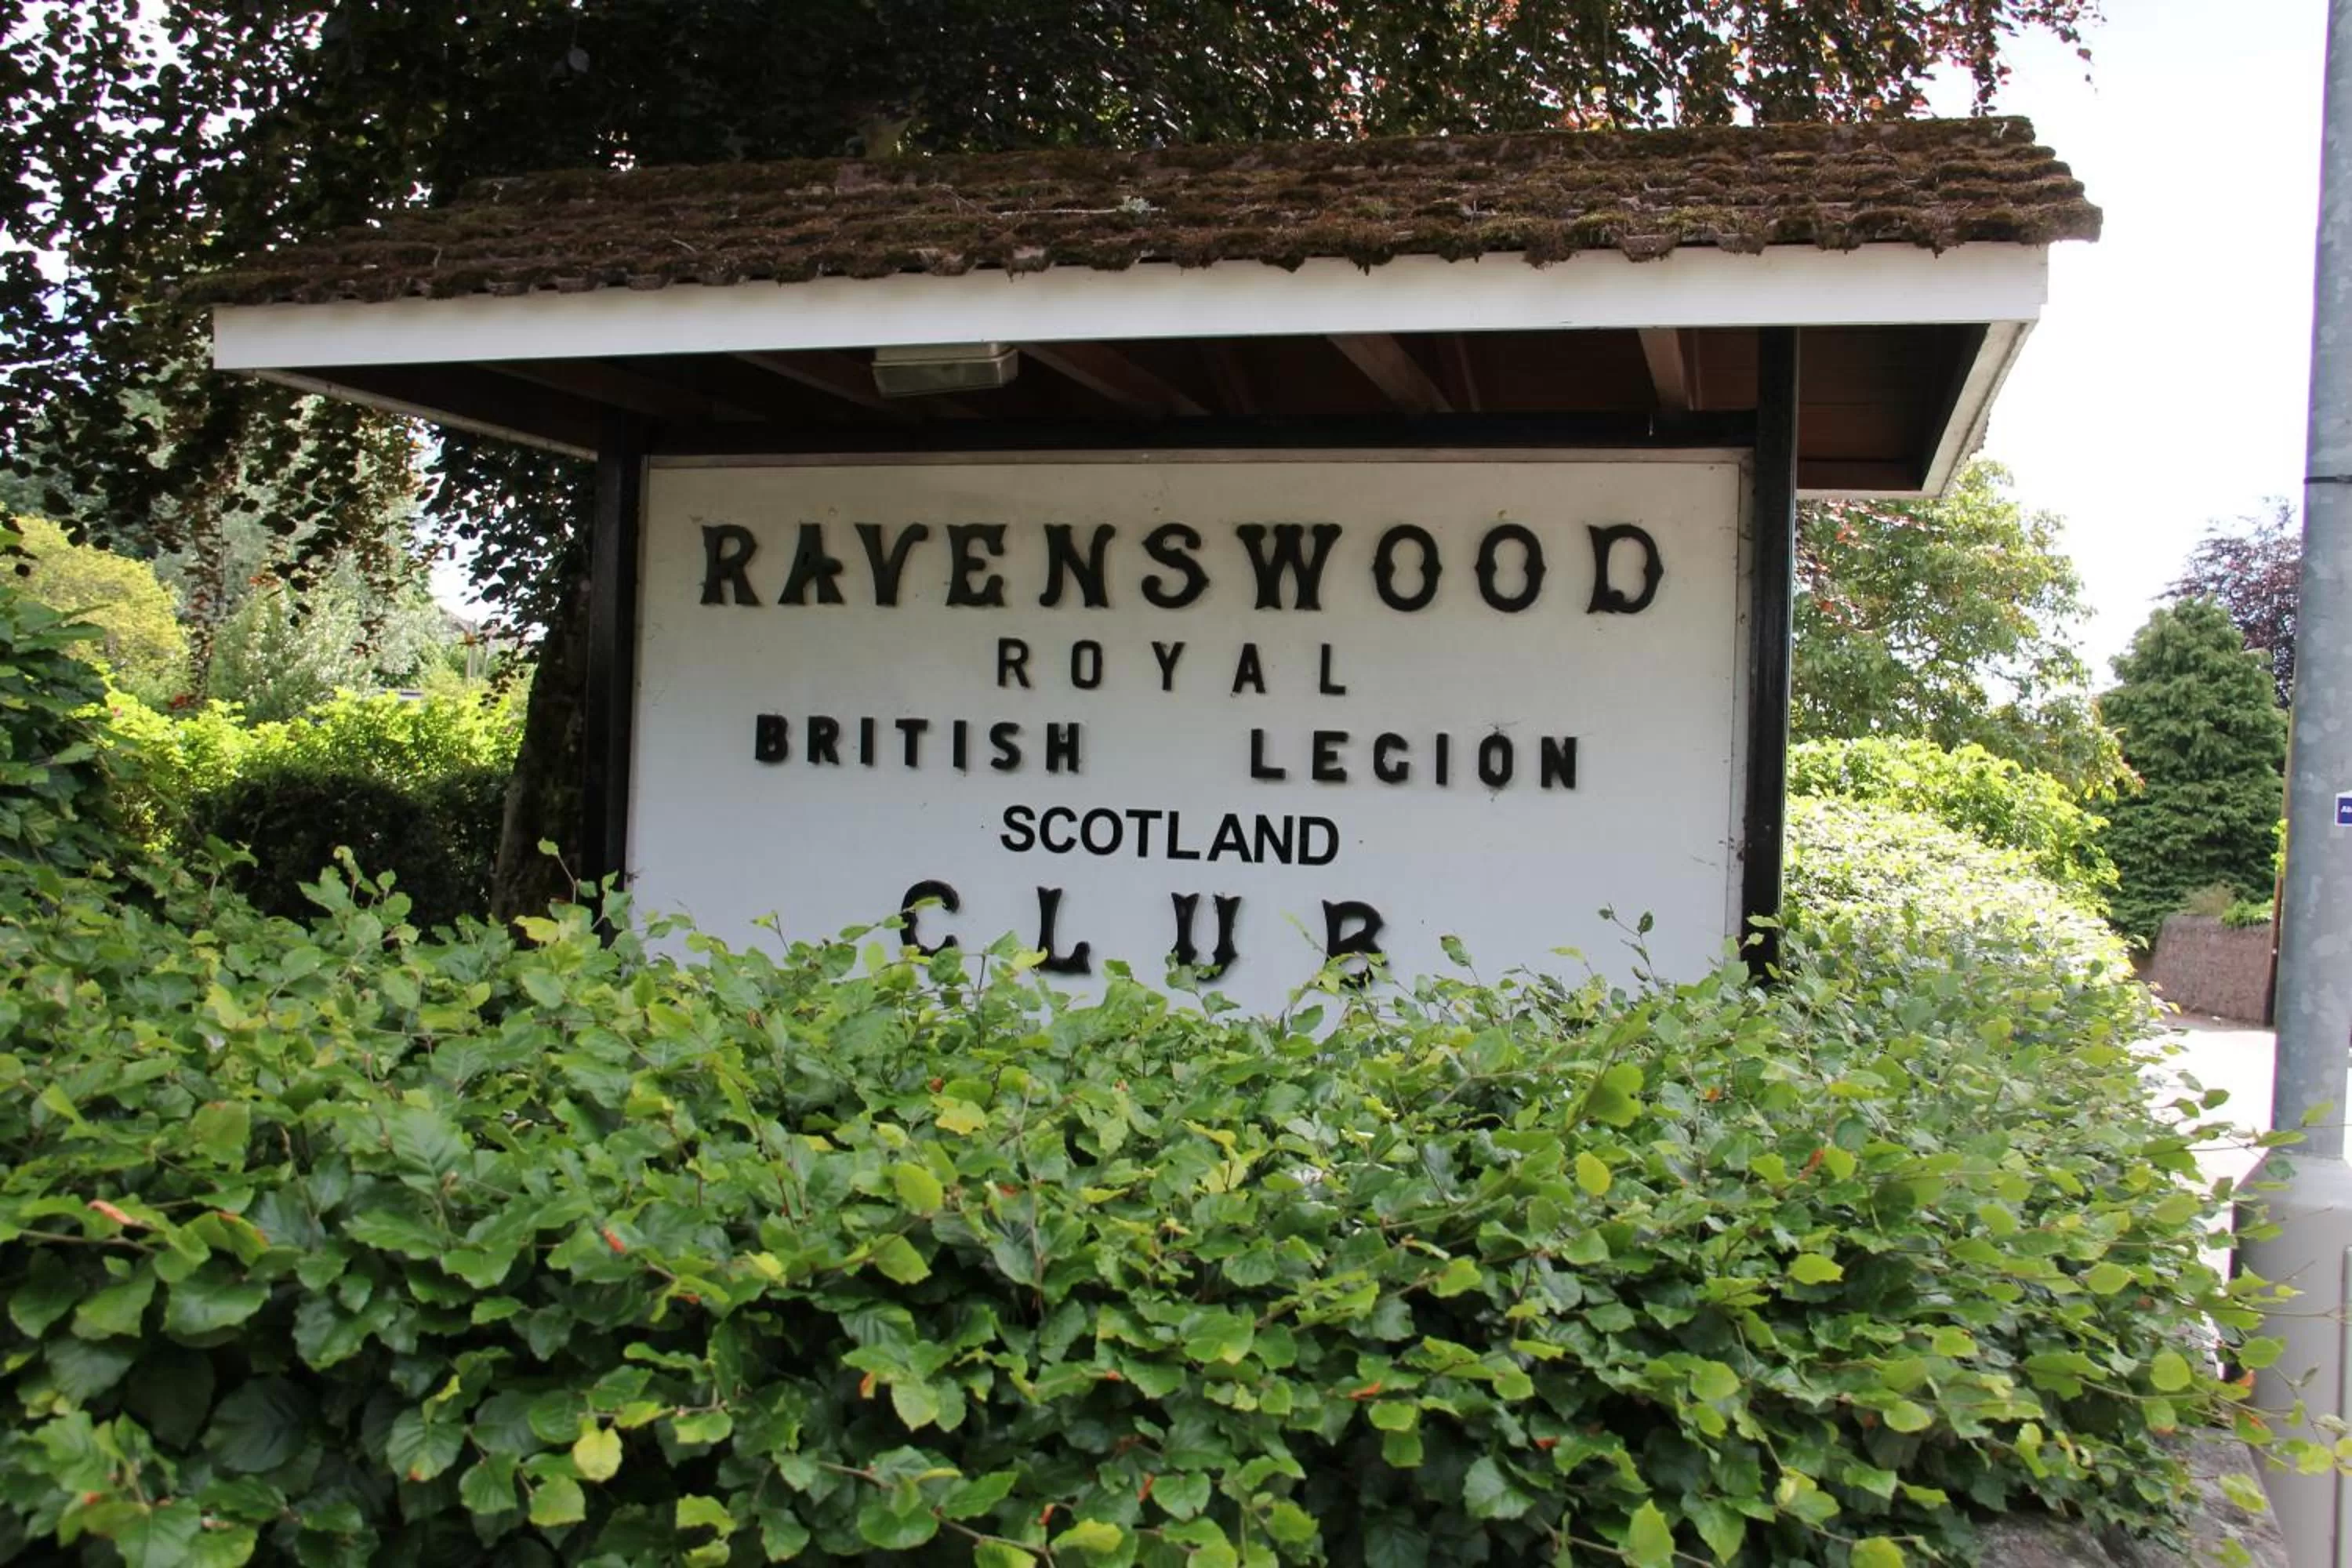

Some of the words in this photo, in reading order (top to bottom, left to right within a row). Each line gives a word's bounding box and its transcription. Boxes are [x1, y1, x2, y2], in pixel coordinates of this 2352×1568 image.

[700, 522, 1664, 614] RAVENSWOOD
[998, 638, 1346, 695] ROYAL
[755, 714, 1080, 773] BRITISH
[1250, 729, 1577, 789] LEGION
[1000, 805, 1339, 866] SCOTLAND
[900, 880, 1388, 989] CLUB
